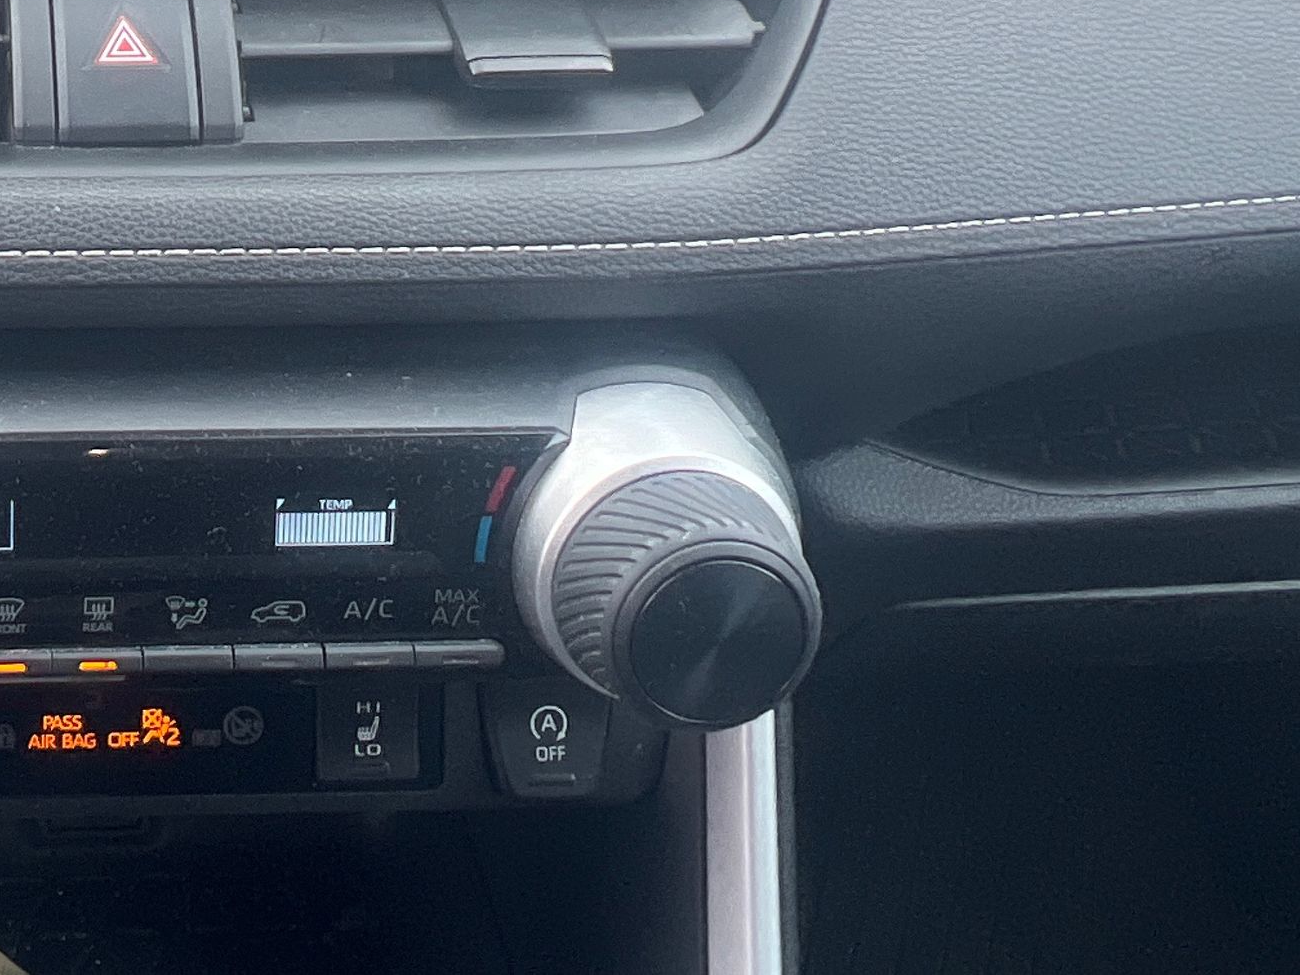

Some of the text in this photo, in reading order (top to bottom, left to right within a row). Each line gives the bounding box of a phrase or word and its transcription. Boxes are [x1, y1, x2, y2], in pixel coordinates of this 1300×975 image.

[319, 499, 353, 511] TEMP
[434, 589, 480, 604] MAX
[343, 598, 394, 621] A/C
[431, 605, 480, 626] A/C
[82, 622, 114, 633] REAR
[356, 701, 381, 714] HI
[42, 714, 83, 731] PASS
[28, 732, 141, 750] AIR BAG OFF
[354, 743, 382, 757] LO
[536, 746, 567, 762] OFF
